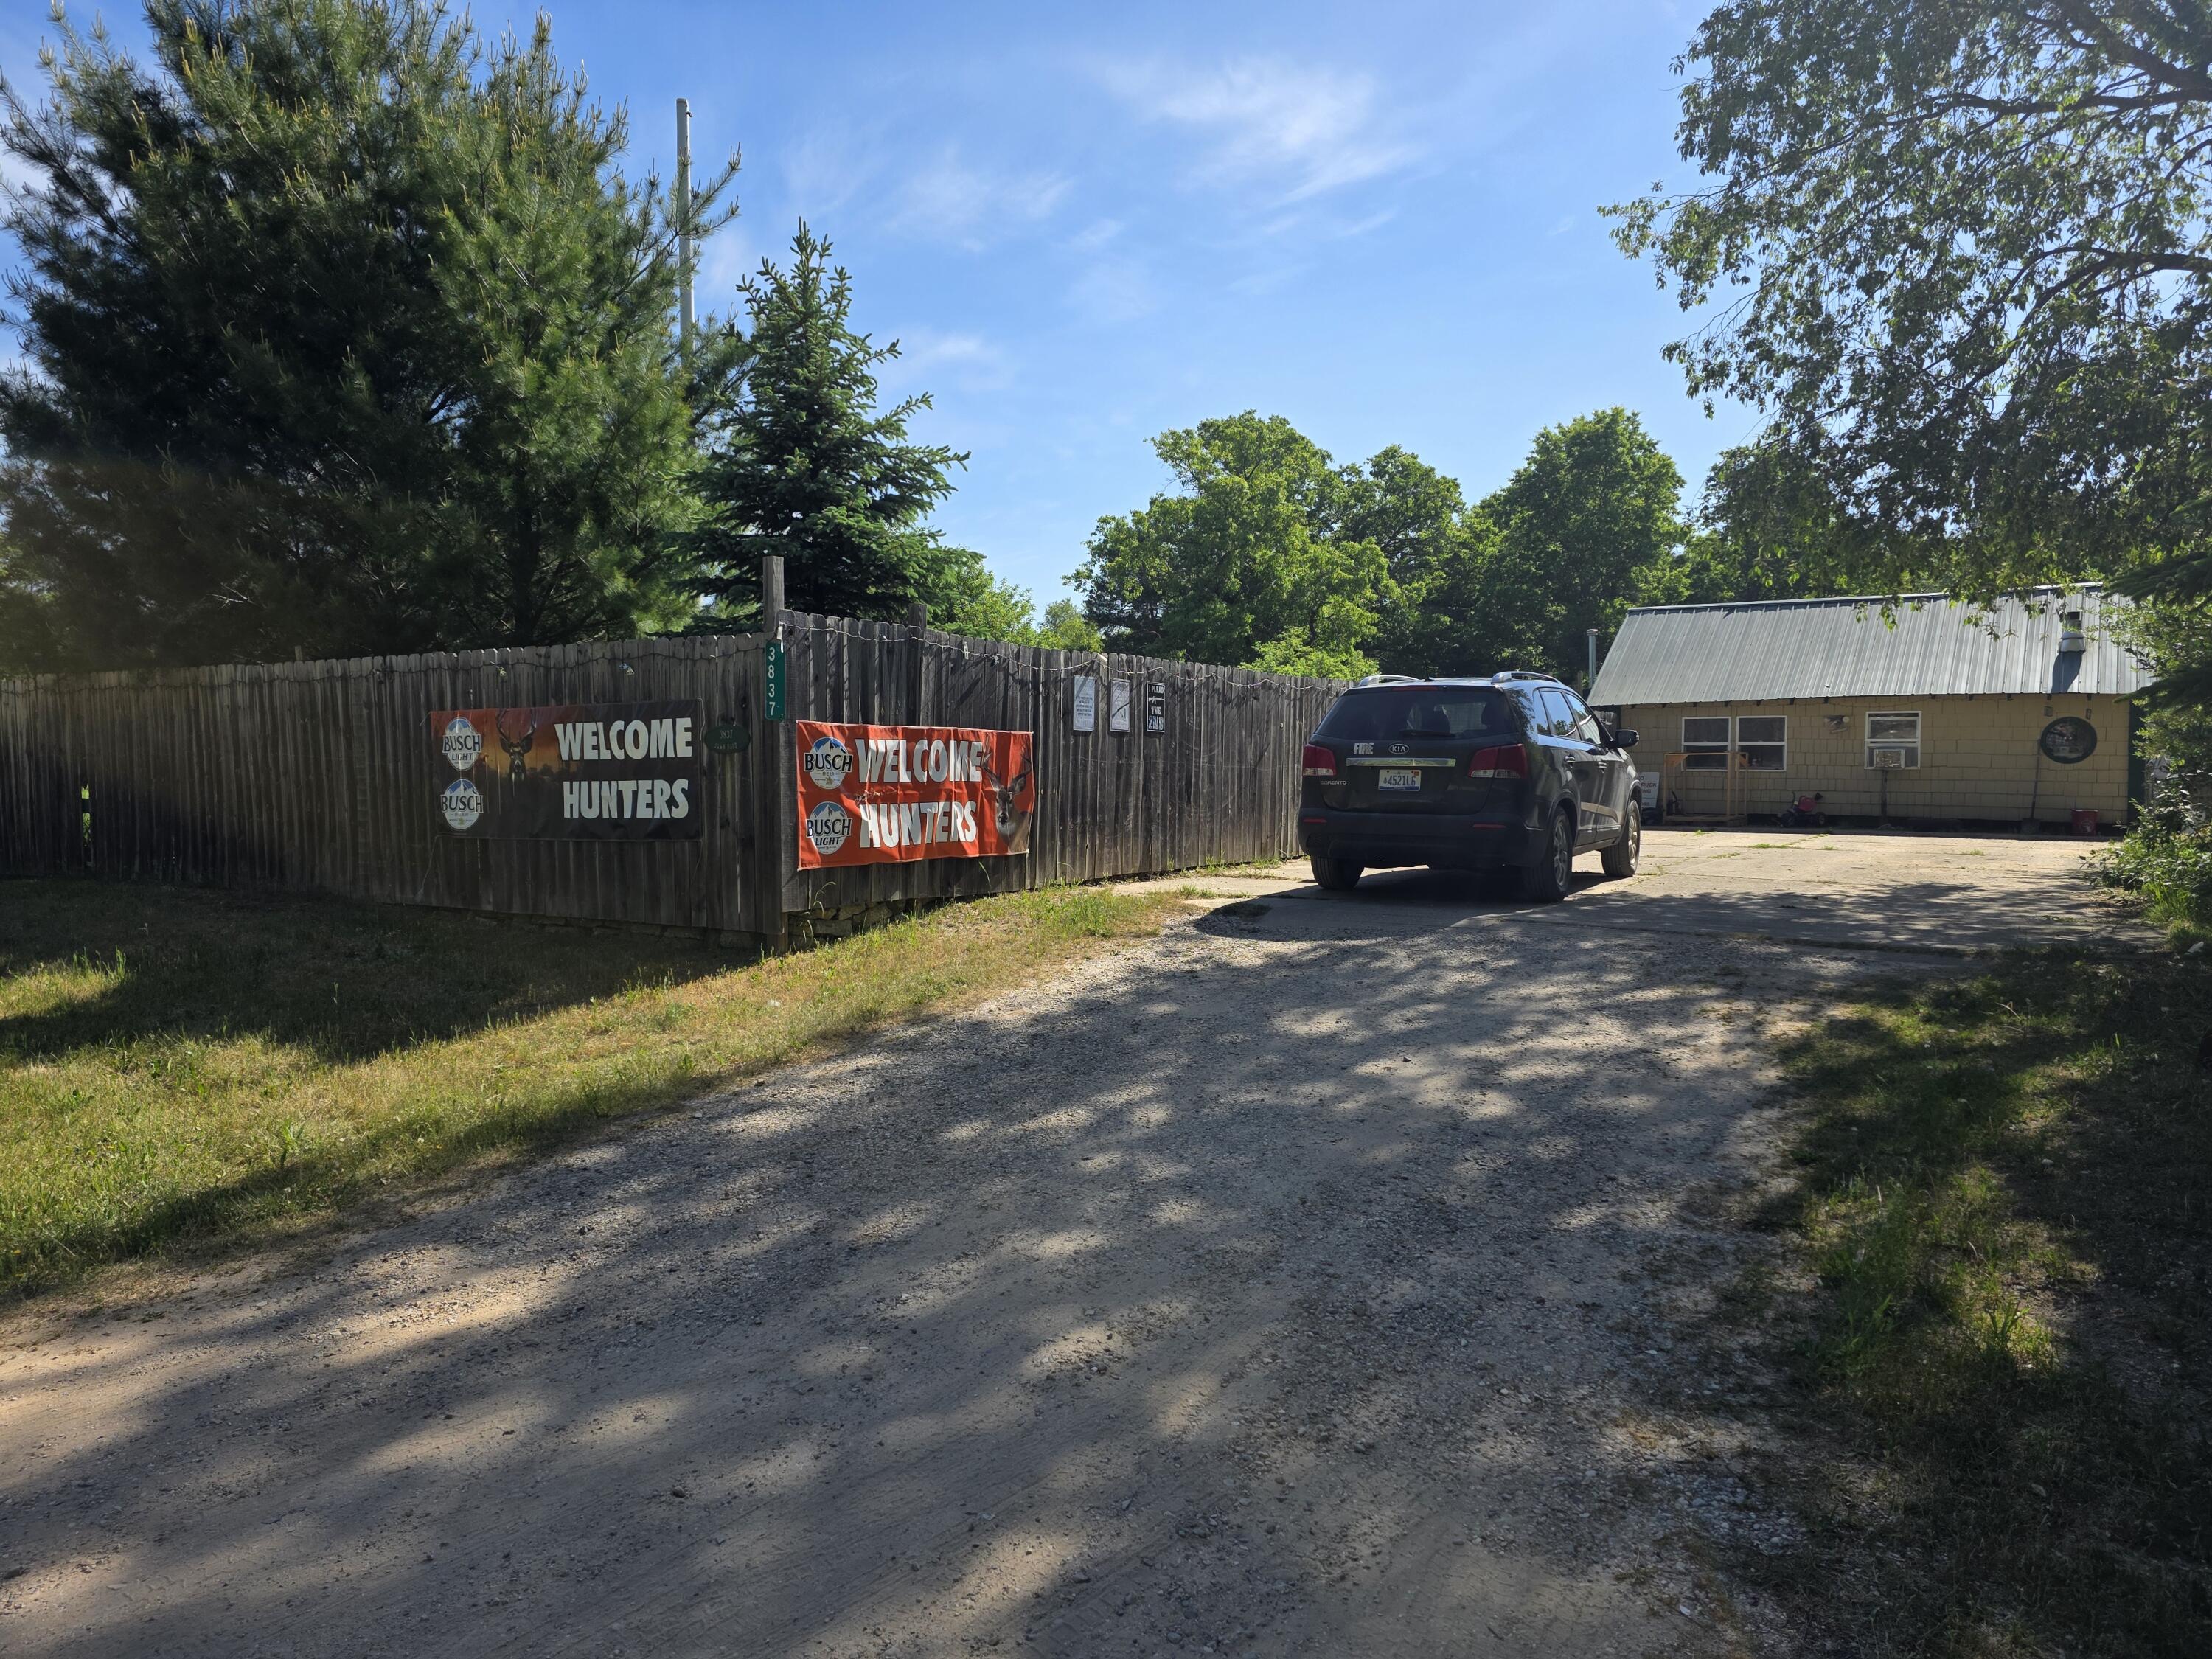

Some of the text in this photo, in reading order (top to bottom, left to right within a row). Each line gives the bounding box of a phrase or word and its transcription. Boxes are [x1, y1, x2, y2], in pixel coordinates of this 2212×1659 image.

[768, 647, 776, 715] 3837
[1151, 706, 1161, 715] THE
[443, 735, 481, 752] BUSCH
[554, 717, 692, 760] WELCOME
[451, 753, 473, 761] LIGHT
[1354, 742, 1374, 755] FIRE
[1392, 745, 1406, 753] KIA
[804, 753, 852, 772] BUSCH
[855, 739, 983, 782] WELCOME
[442, 796, 482, 812] BUSCH
[563, 779, 689, 819] HUNTERS
[807, 818, 851, 837] BUSCH
[860, 801, 977, 848] HUNTERS
[815, 837, 841, 846] LIGHT
